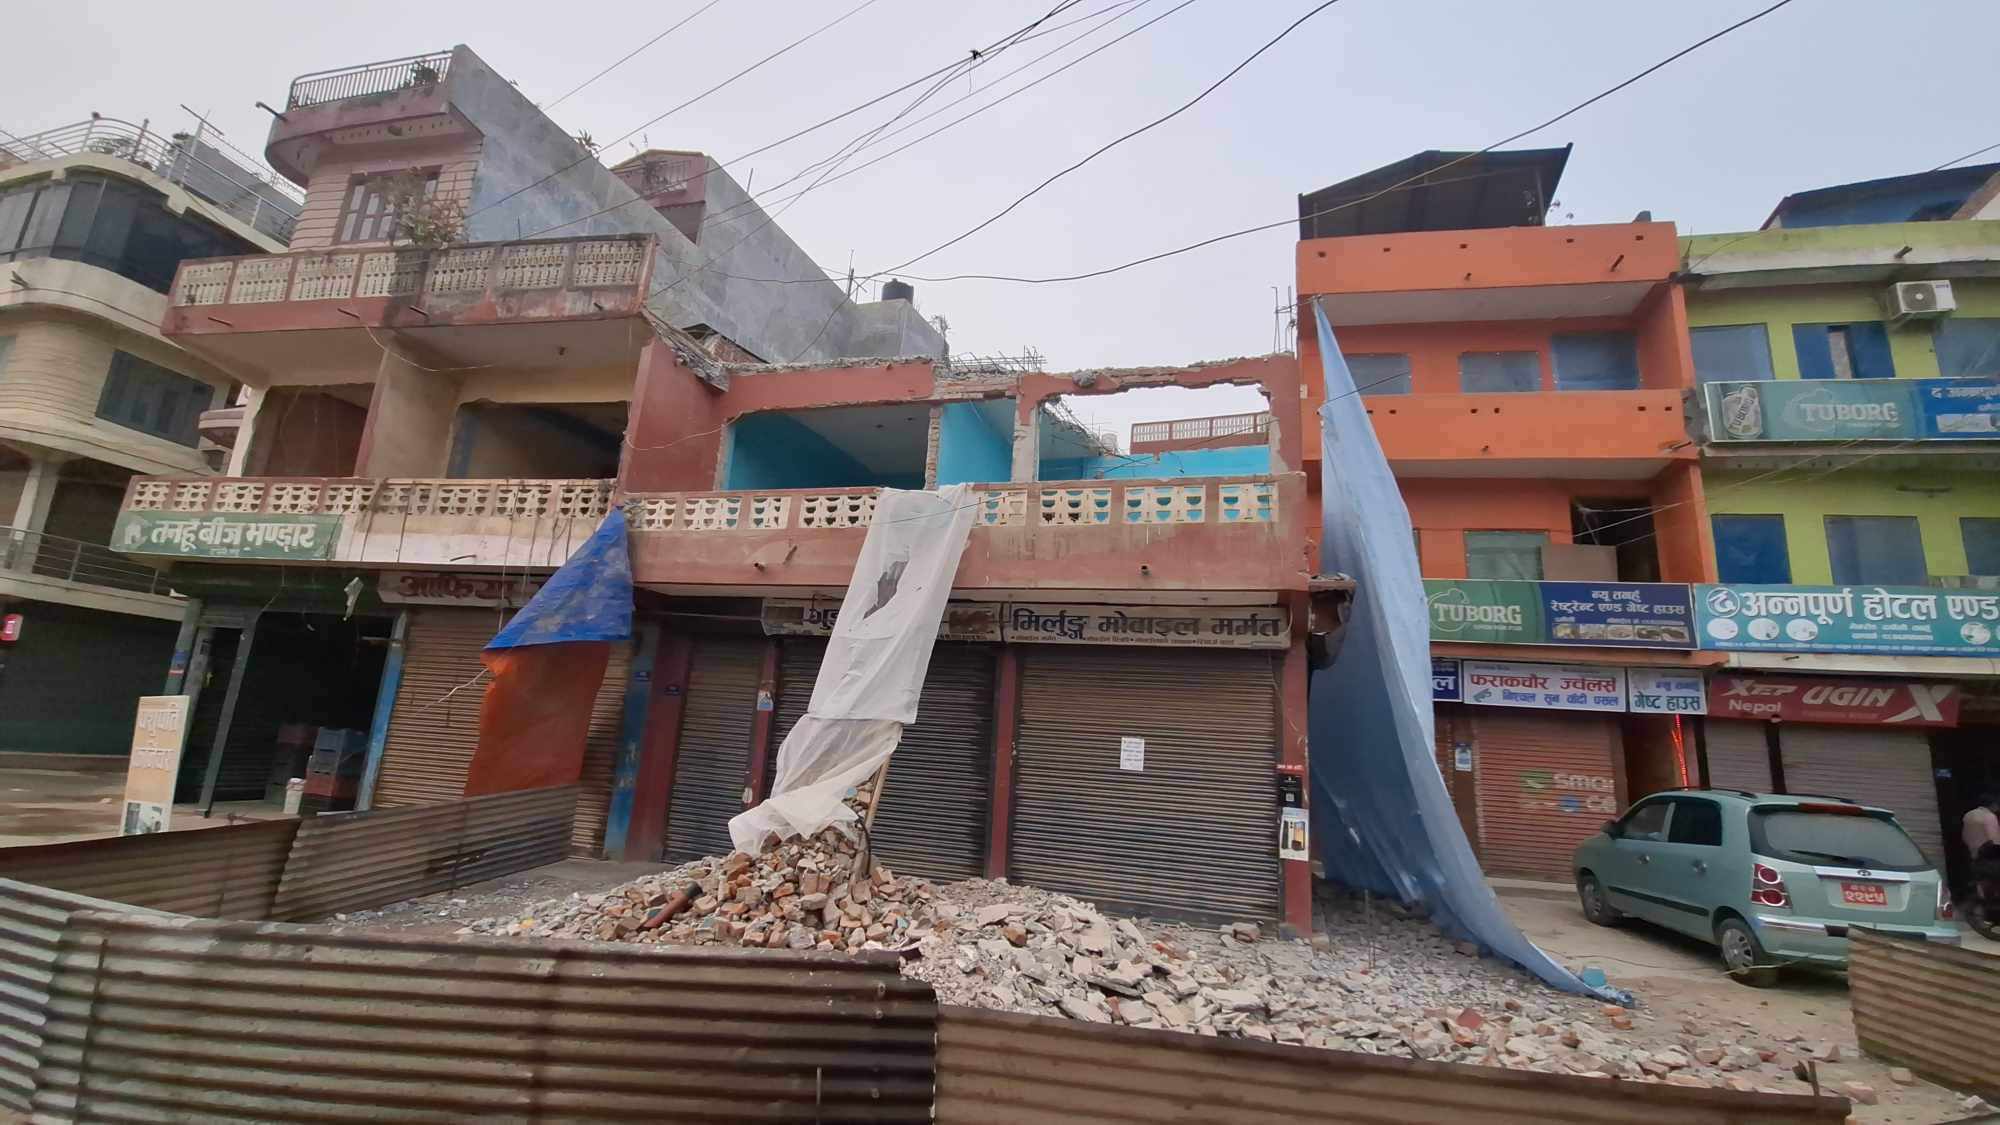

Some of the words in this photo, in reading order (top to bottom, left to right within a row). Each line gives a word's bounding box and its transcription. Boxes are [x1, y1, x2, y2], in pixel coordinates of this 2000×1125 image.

[1804, 402, 1899, 423] TUBORG
[199, 516, 243, 545] बीज
[246, 522, 317, 552] भण्डार
[1434, 603, 1522, 625] TUBORG
[1740, 587, 1853, 625] अन्नपूर्ण
[1862, 588, 1937, 620] होटल
[1944, 595, 2000, 620] एण्ड
[1211, 614, 1281, 637] मर्मत
[1666, 694, 1701, 711] हाउस
[1728, 699, 1782, 714] Nepal
